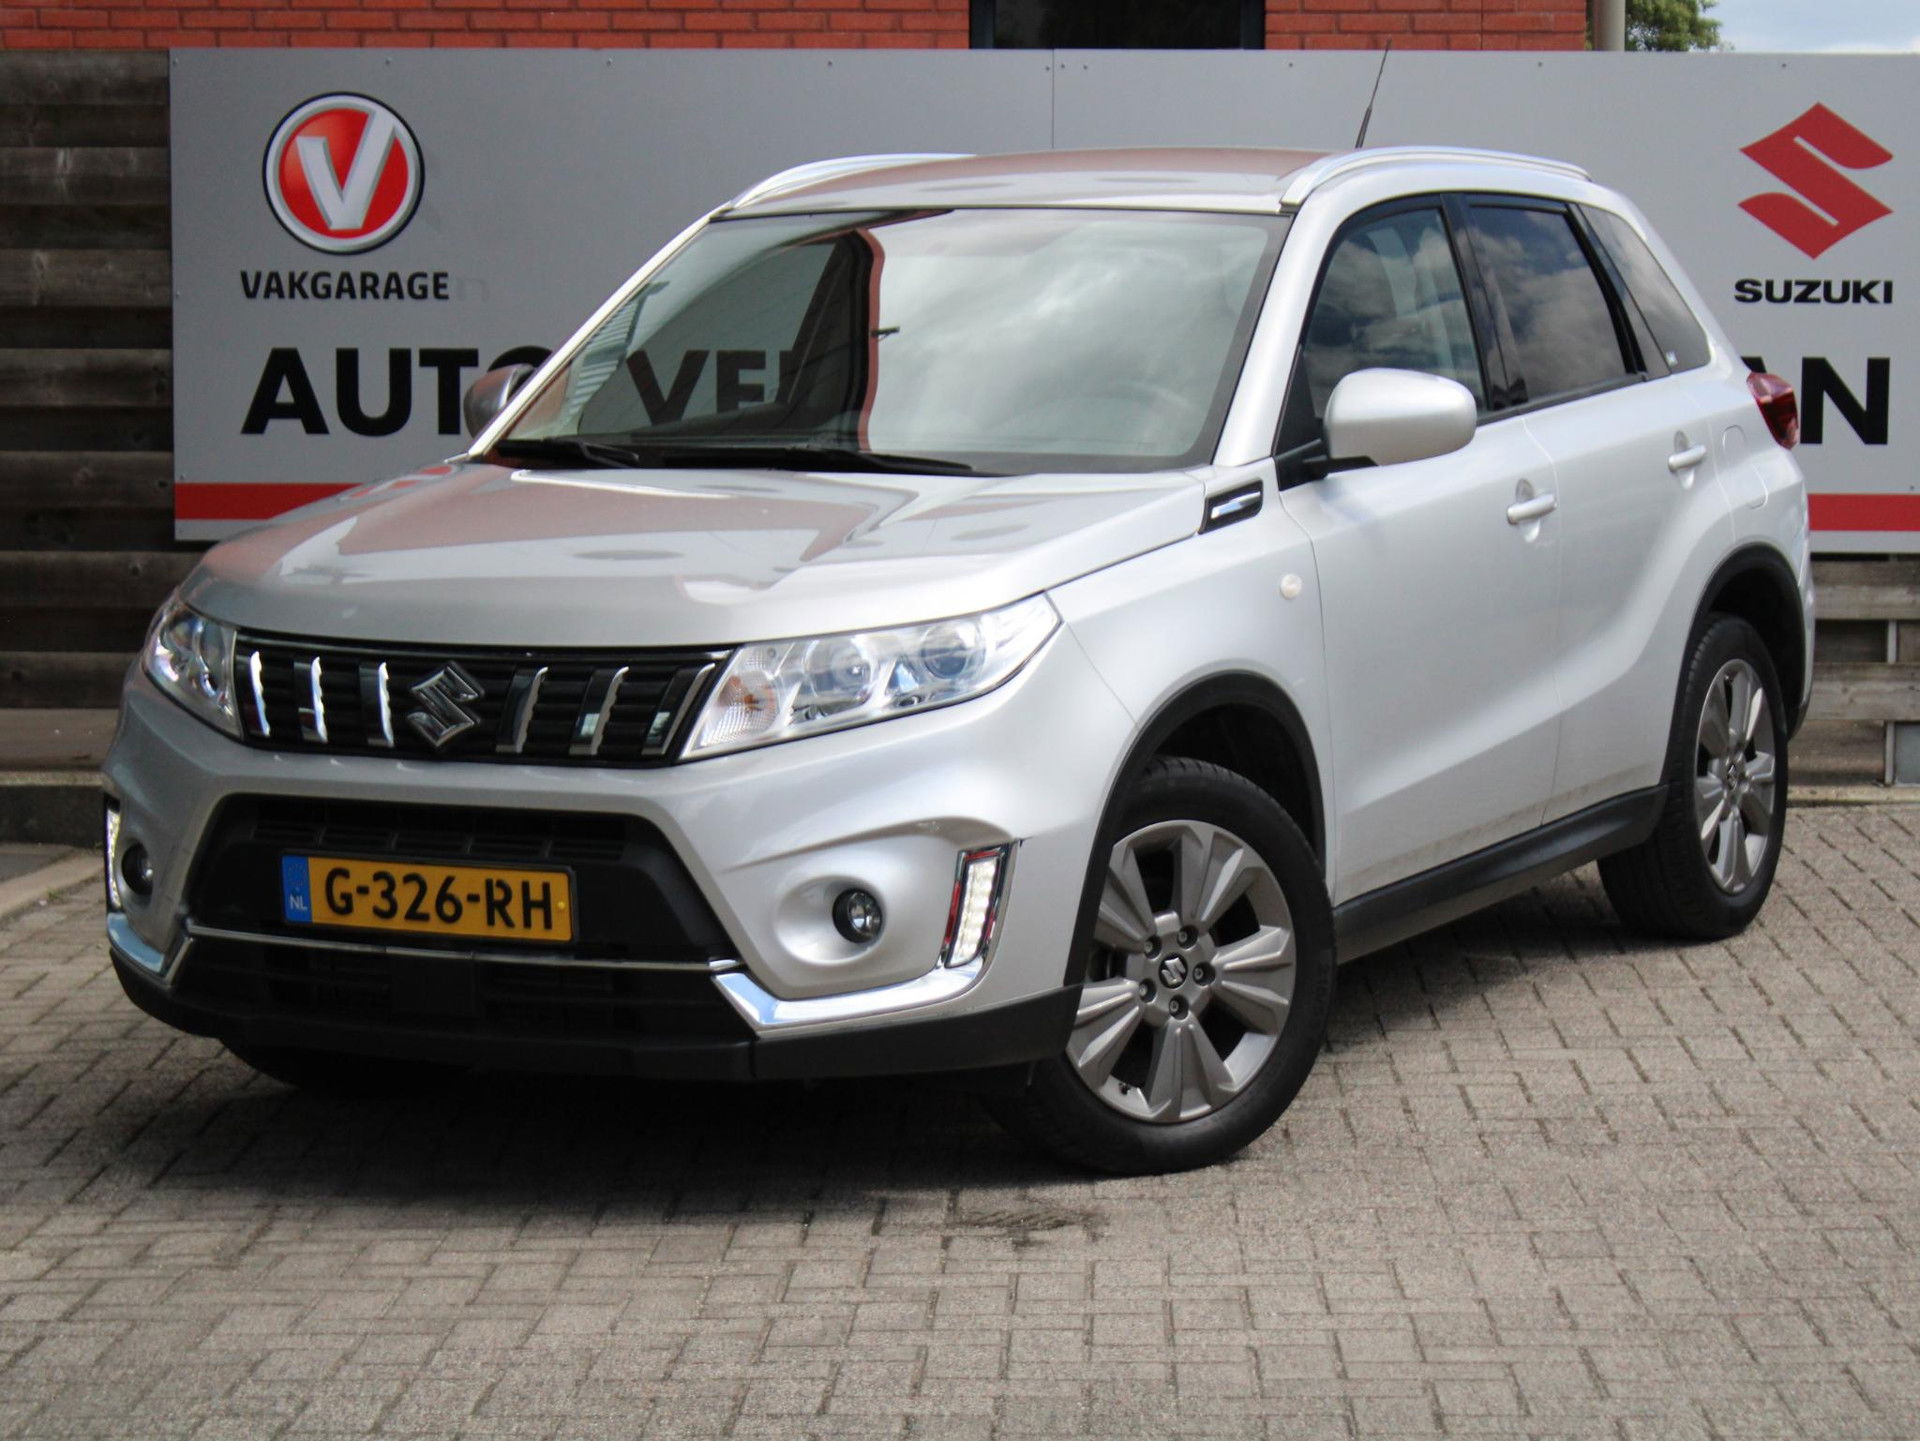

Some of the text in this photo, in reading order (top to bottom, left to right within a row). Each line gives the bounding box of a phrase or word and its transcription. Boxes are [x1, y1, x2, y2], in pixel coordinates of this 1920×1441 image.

[240, 270, 450, 300] VAKGARAGE
[1734, 279, 1894, 304] SUZUKI
[240, 346, 553, 437] AUT
[289, 895, 308, 911] NL
[324, 867, 553, 930] G-326-RH
